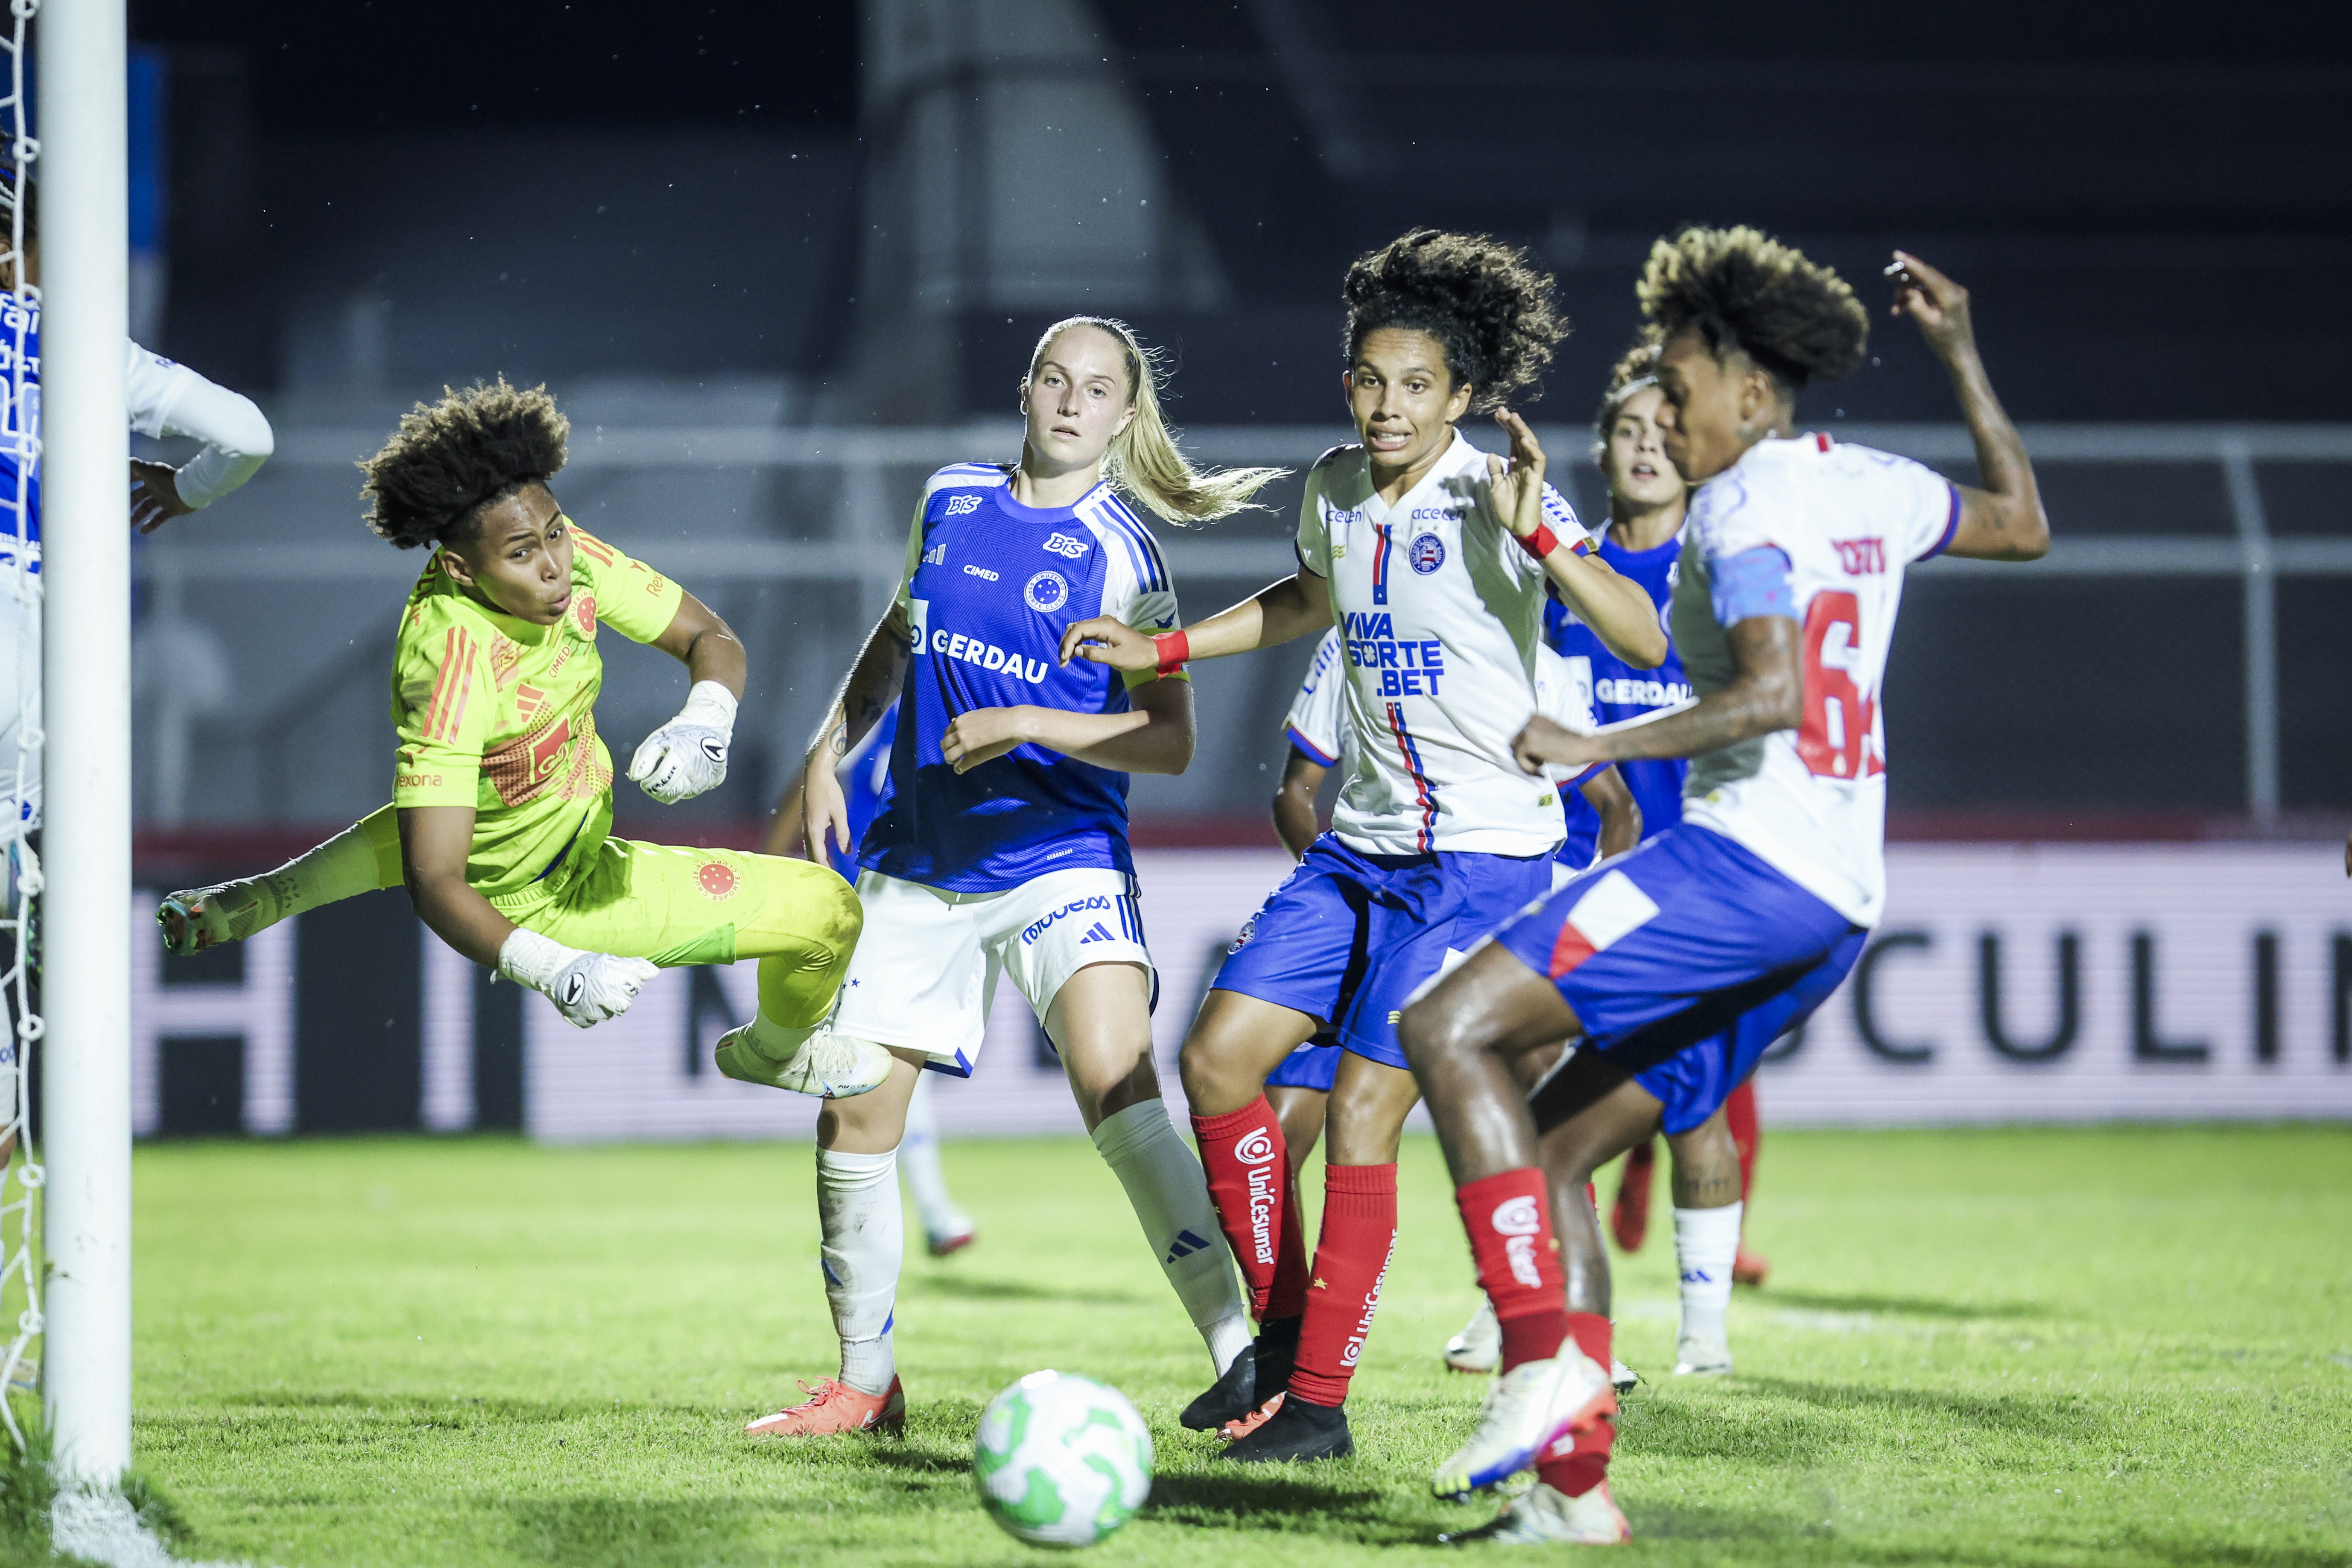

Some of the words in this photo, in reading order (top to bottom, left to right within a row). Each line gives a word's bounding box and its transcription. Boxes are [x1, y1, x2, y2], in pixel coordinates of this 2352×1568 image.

[1324, 511, 1362, 523] celen
[963, 564, 999, 582] CIMED
[1036, 574, 1065, 590] CRUZEIRO
[1028, 582, 1043, 608] ESPORTE
[1045, 594, 1064, 609] CLUBE
[1339, 611, 1395, 640] VIVA
[548, 645, 571, 678] CIMED
[932, 628, 1049, 684] GERDAU
[1345, 639, 1443, 668] SORTE
[1376, 668, 1444, 697] .BET
[693, 861, 709, 896] CRUZEIRO
[713, 876, 741, 901] ESPORTE
[1247, 1165, 1277, 1264] UniCesumar
